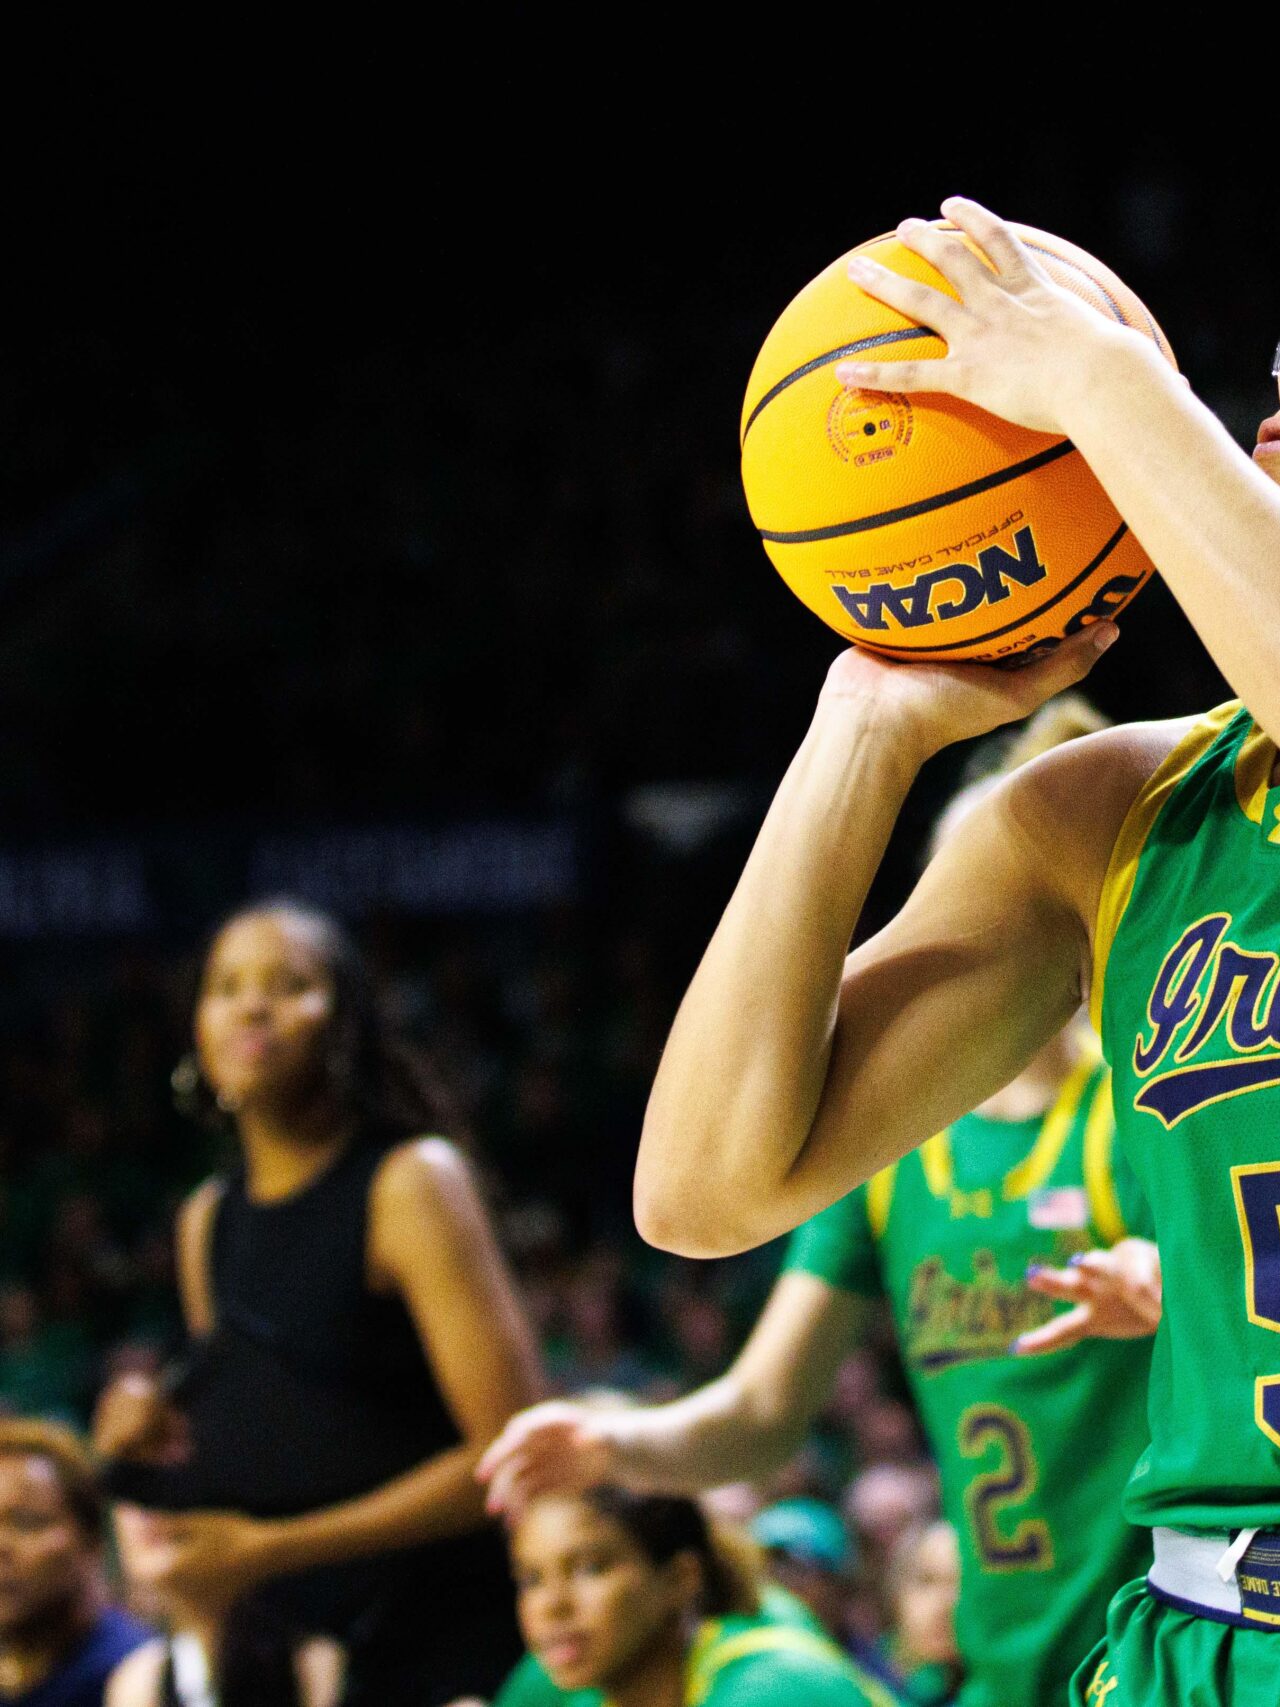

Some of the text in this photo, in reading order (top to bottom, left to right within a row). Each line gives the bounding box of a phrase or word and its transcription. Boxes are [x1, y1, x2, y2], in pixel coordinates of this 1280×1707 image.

[824, 508, 1025, 580] OFFICIAL GAME BALL
[830, 524, 1048, 631] NCAA
[997, 633, 1037, 655] EVO
[956, 1402, 1055, 1575] 2
[1240, 1574, 1270, 1596] DAME
